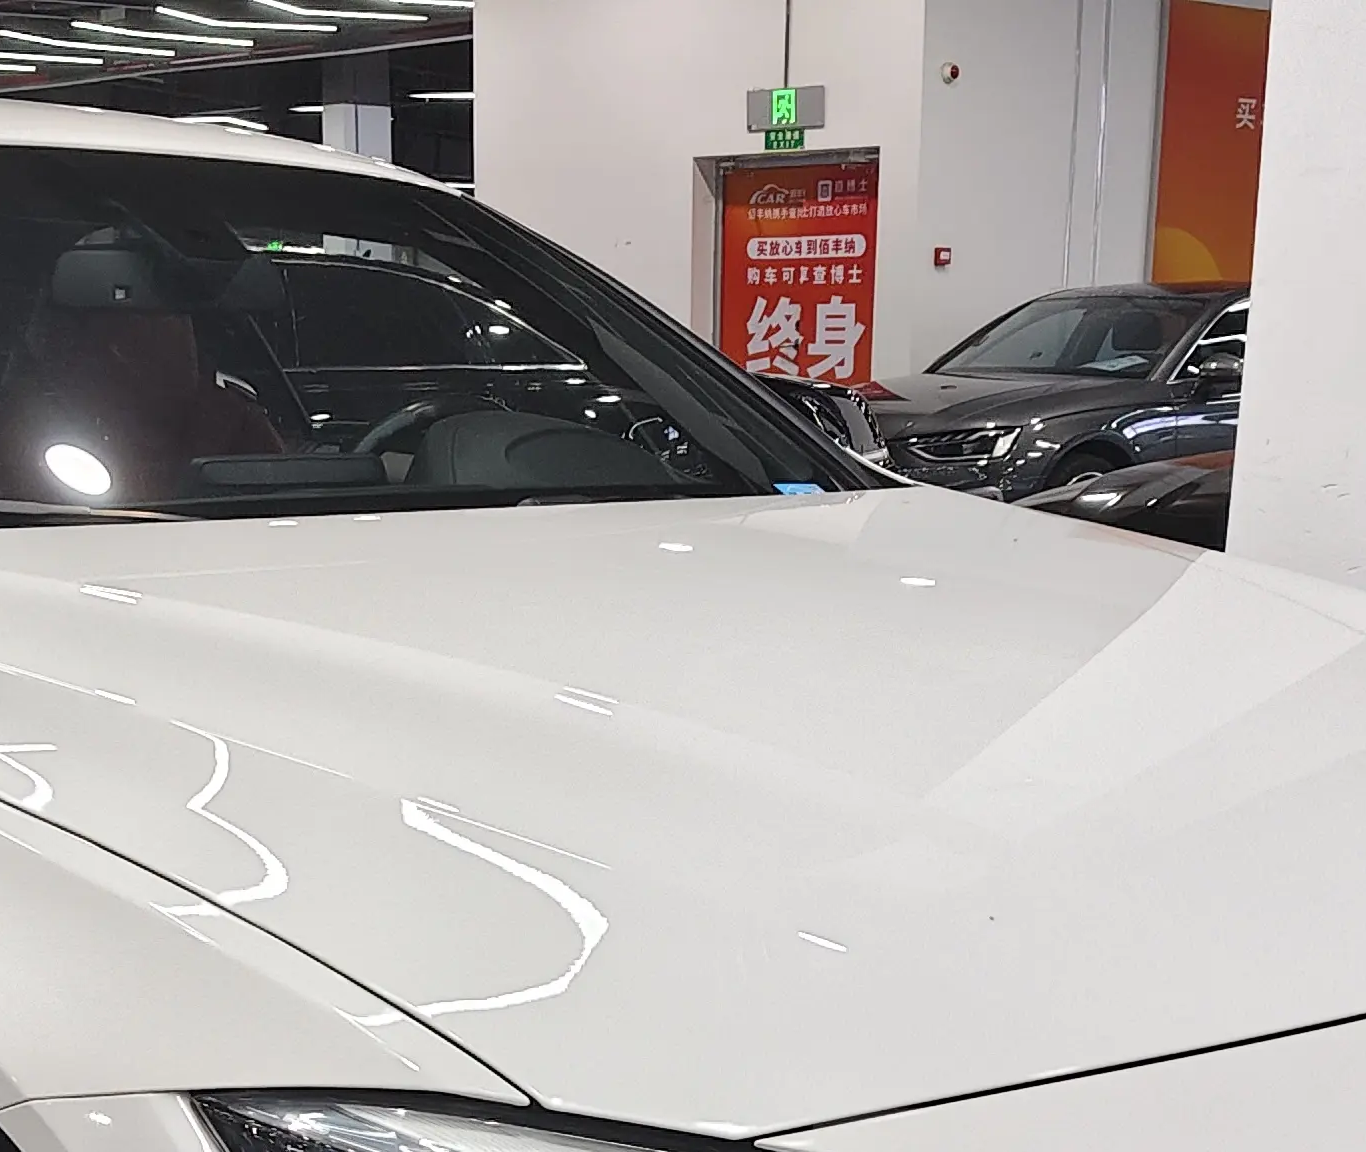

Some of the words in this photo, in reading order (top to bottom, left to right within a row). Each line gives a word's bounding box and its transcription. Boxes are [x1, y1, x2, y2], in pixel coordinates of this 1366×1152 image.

[1236, 98, 1264, 129] 买
[756, 193, 787, 204] CAR
[756, 238, 856, 257] 买放心车到佰丰纳
[745, 294, 866, 379] 终身
